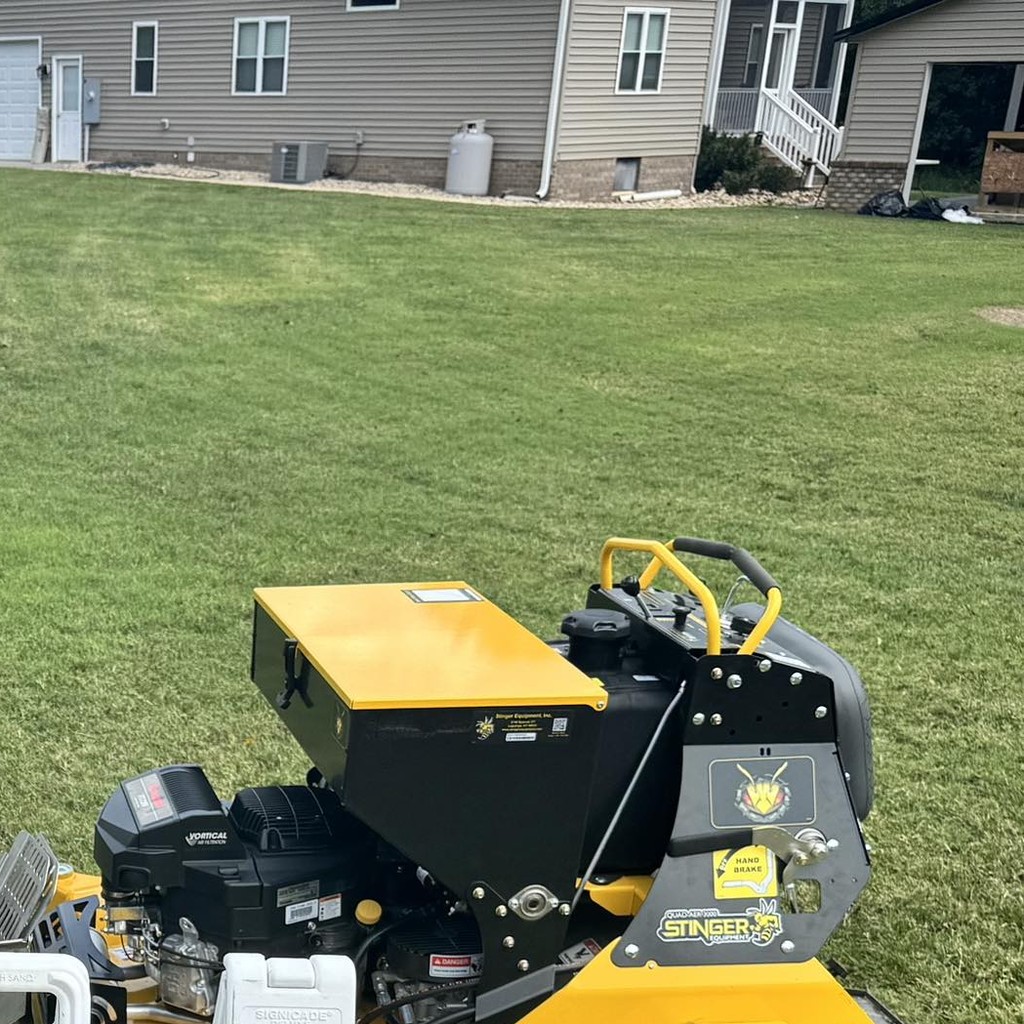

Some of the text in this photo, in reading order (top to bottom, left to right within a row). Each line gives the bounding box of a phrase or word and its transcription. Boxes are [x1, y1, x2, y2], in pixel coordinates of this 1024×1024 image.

[188, 832, 228, 840] VORTICAL
[663, 919, 749, 940] STINGER
[709, 934, 749, 942] EQUIPMENT
